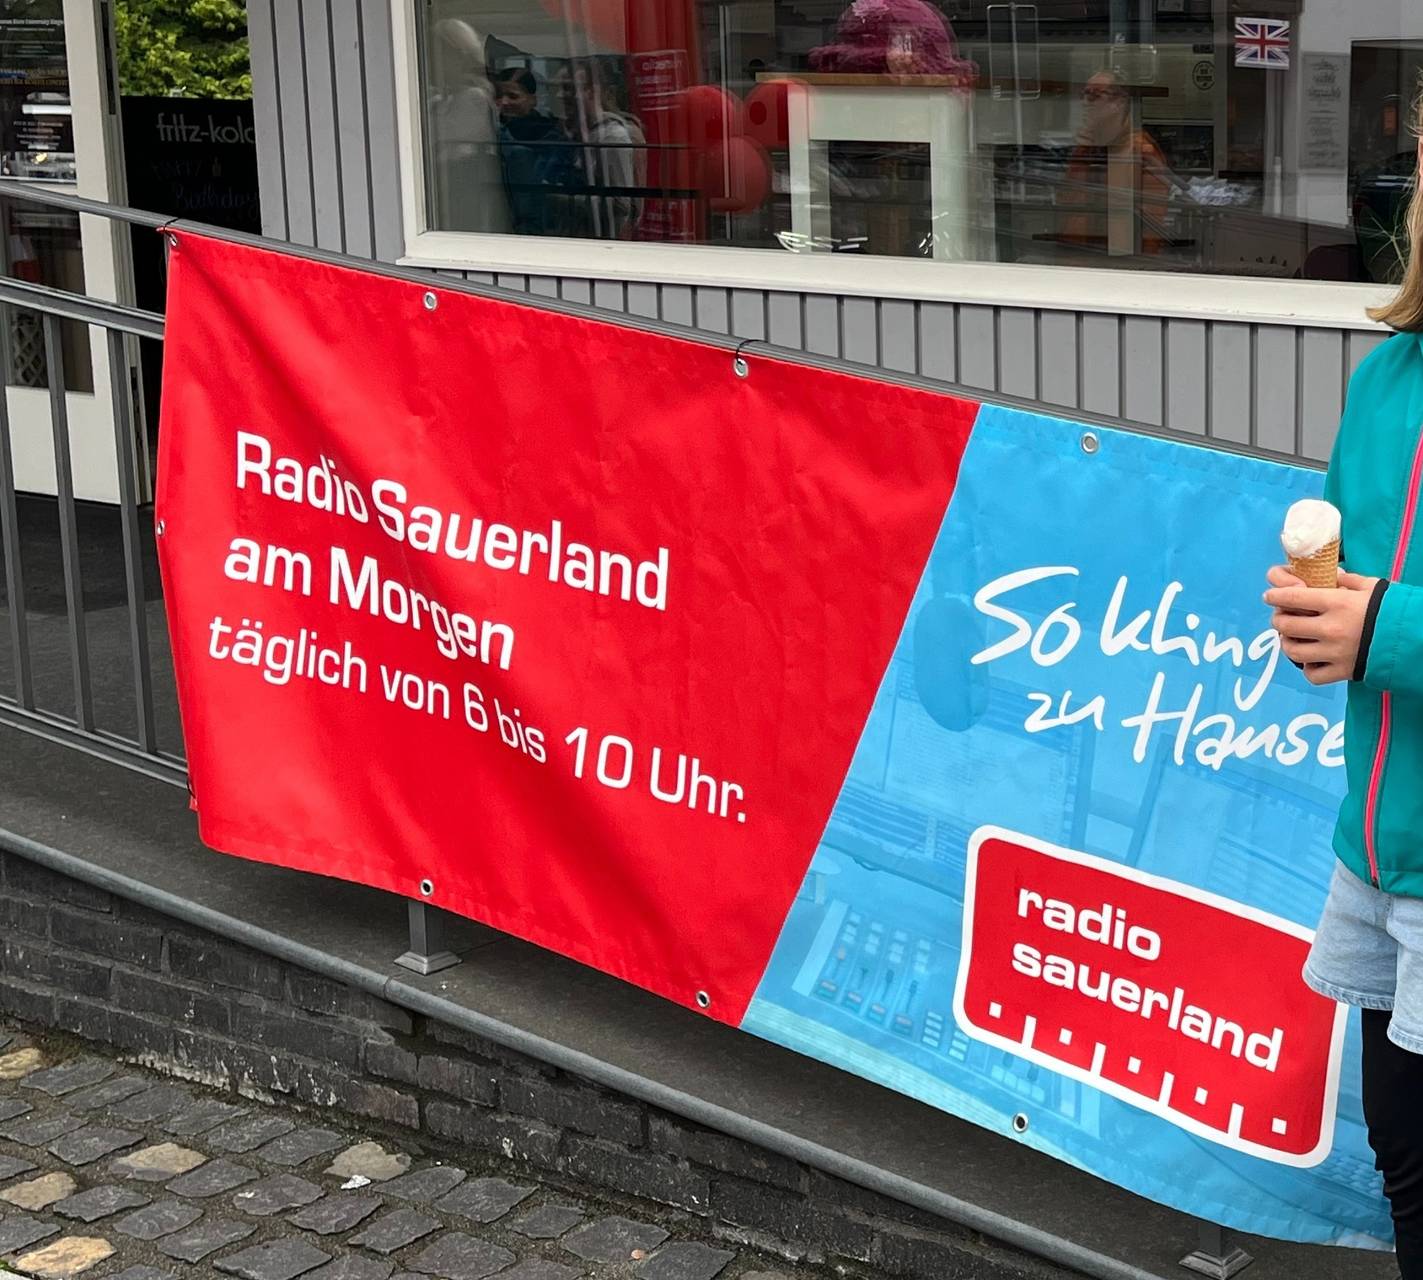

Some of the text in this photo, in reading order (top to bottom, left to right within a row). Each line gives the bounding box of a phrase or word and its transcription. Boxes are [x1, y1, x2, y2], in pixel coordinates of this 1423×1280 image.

[236, 430, 669, 611] Radio Sauerland
[224, 537, 515, 670] am Morgen
[970, 566, 1281, 712] So kling
[208, 616, 747, 823] täglich von 6 bis 10 Uhr.
[1024, 690, 1106, 733] zu
[1017, 887, 1162, 961] radio
[1011, 942, 1284, 1073] sauerland
